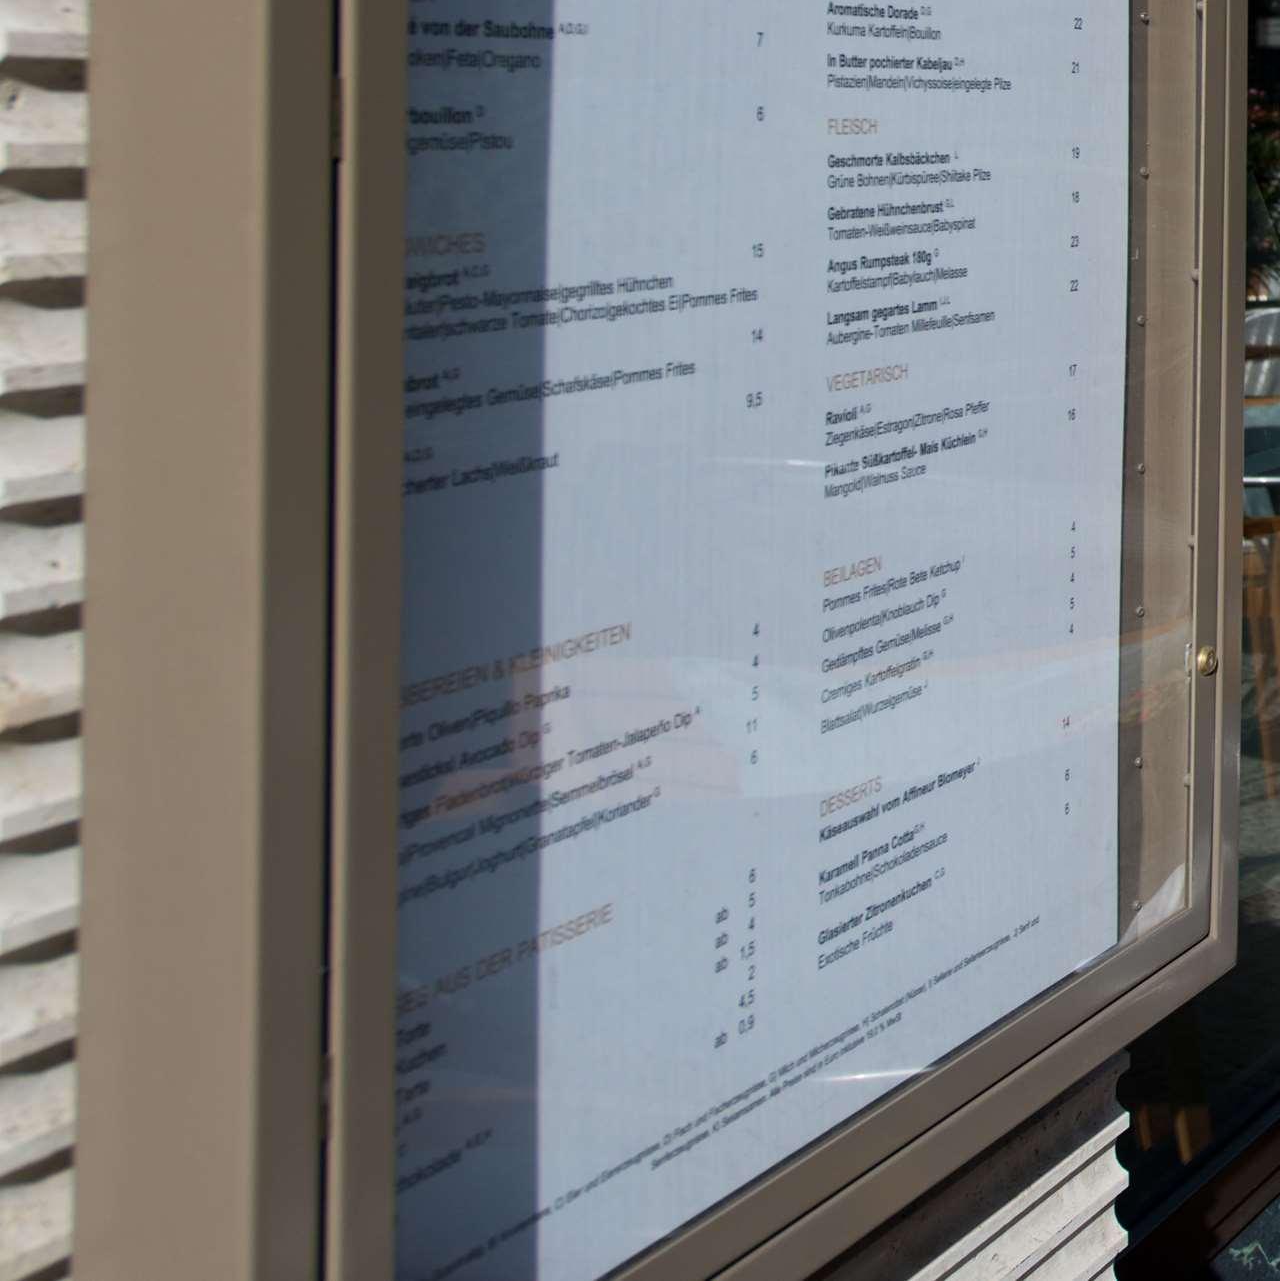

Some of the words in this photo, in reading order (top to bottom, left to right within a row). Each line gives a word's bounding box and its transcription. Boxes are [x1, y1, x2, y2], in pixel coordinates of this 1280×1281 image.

[828, 2, 885, 18] Aromatische
[887, 5, 918, 19] Dorade
[454, 20, 479, 37] der
[483, 19, 555, 40] Saubohne
[827, 22, 865, 37] Kurkuma
[1074, 17, 1083, 30] 22
[757, 33, 763, 47] 7
[827, 54, 836, 67] In
[839, 54, 867, 68] Butter
[869, 57, 914, 71] pochierter
[917, 57, 952, 72] Kabeljau
[1072, 60, 1080, 73] 21
[994, 77, 1012, 91] Pilze
[757, 108, 763, 121] 6
[828, 119, 878, 135] FLEISCH
[828, 154, 883, 168] Geschmorte
[886, 152, 950, 166] Kalbsbäckchen
[1072, 147, 1080, 158] 19
[828, 175, 855, 189] Grüne
[973, 169, 991, 182] Pilze
[828, 206, 874, 220] Gebratene
[877, 202, 944, 216] Hühnchenbrust
[1071, 236, 1079, 247] 23
[752, 244, 764, 258] 15
[828, 257, 858, 274] Angus
[860, 252, 910, 271] Rumpsteak
[912, 250, 932, 266] 180g
[617, 276, 673, 291] Hühnchen
[1070, 280, 1078, 292] 22
[730, 288, 758, 304] Frites
[827, 308, 869, 326] Langsam
[871, 305, 909, 322] gegartes
[912, 300, 937, 313] Lamm
[752, 328, 763, 343] 14
[666, 361, 695, 377] Frites
[1068, 364, 1077, 376] 17
[826, 364, 908, 392] VEGETARISCH
[747, 392, 762, 409] 9,5
[965, 400, 990, 417] Pfeffer
[825, 409, 858, 426] Ravioli
[825, 461, 859, 478] Pikante
[920, 439, 939, 455] Mais
[941, 432, 976, 451] Küchlein
[901, 463, 926, 480] Sauce
[1071, 522, 1076, 531] 4
[1071, 547, 1075, 558] 5
[824, 556, 881, 587] BEILAGEN
[1070, 573, 1075, 583] 4
[822, 592, 861, 613] Pommes
[909, 568, 928, 585] Bete
[929, 560, 961, 579] Ketchup
[926, 594, 940, 610] Dip
[1070, 598, 1075, 609] 5
[1069, 623, 1074, 634] 4
[822, 646, 873, 673] Gedämpftes
[821, 678, 862, 704] Cremiges
[864, 657, 920, 688] Kartoffelgratin
[752, 687, 758, 701] 5
[675, 711, 692, 730] Dip
[819, 803, 879, 843] Käseauswahl
[881, 796, 900, 814] vom
[902, 780, 935, 805] Affineur
[938, 762, 976, 789] Blomeyer
[820, 777, 882, 817] DESSERTS
[819, 855, 859, 885] Karamell
[862, 841, 889, 865] Panna
[891, 830, 914, 853] Cotta
[749, 892, 756, 908] 5
[715, 907, 728, 924] ab
[818, 912, 863, 945] Glasierter
[866, 877, 932, 921] Zitronenkuchen
[517, 903, 613, 963] PATISSERIE
[715, 931, 728, 949] ab
[818, 940, 860, 970] Exotische
[862, 920, 893, 948] Früchte
[715, 956, 728, 973] ab
[748, 966, 755, 980] 2
[739, 989, 755, 1008] 4,5
[714, 1032, 728, 1049] ab
